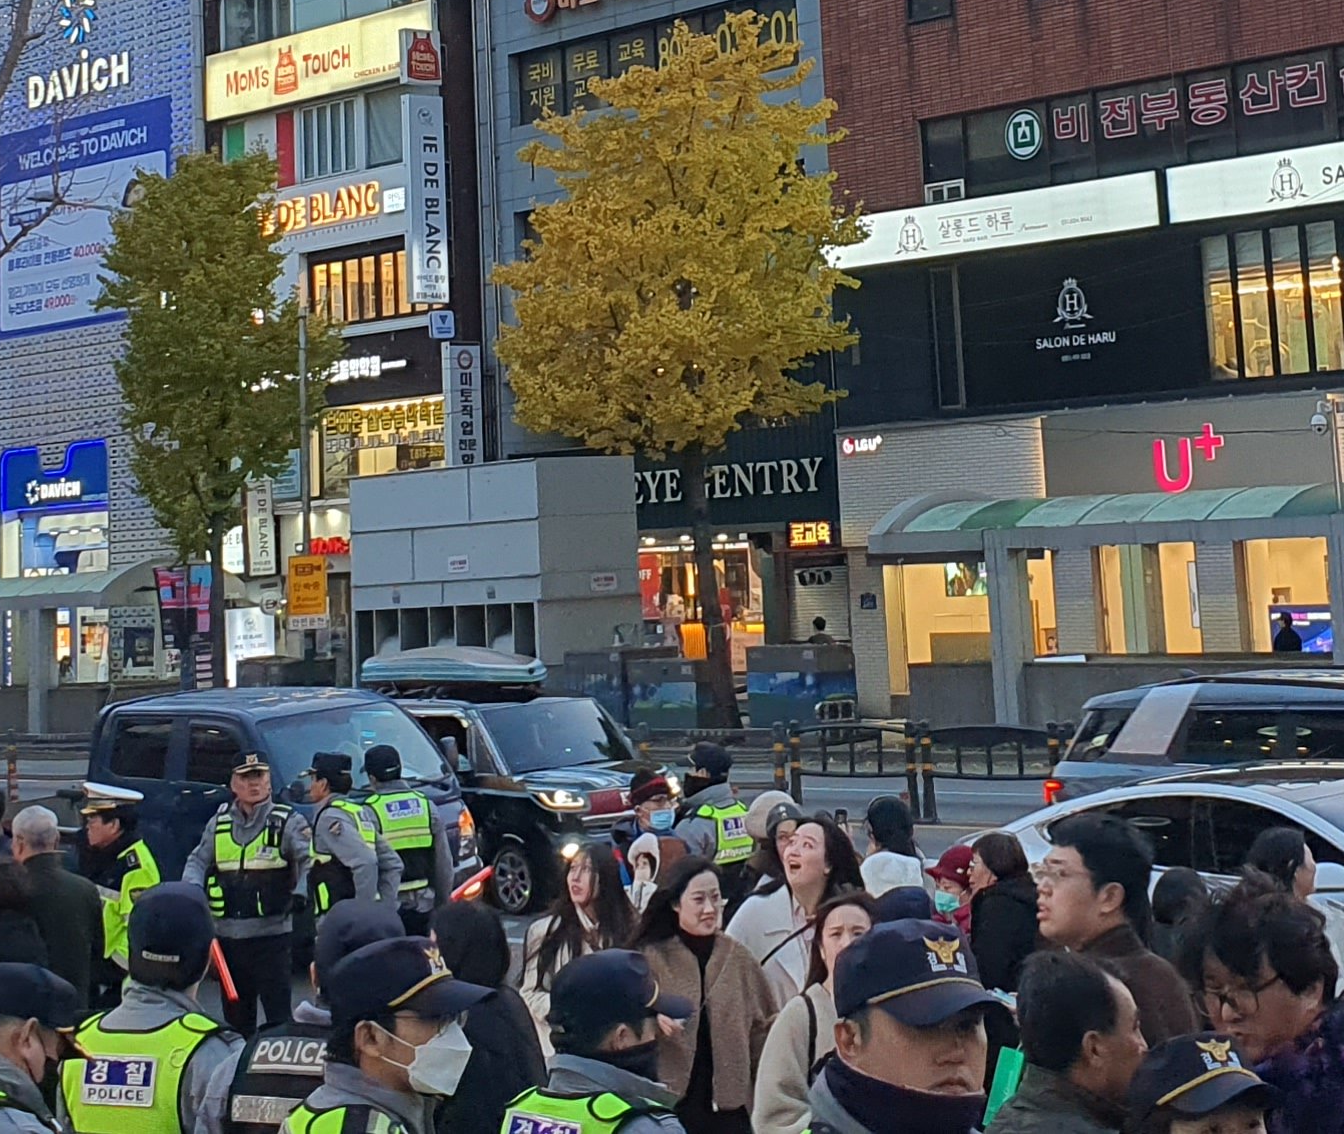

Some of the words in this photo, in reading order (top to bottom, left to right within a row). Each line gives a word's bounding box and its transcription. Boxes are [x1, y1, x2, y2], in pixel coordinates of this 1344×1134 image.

[302, 44, 351, 79] TOUCH
[572, 49, 600, 72] 무료
[618, 39, 646, 62] 교육
[527, 61, 554, 83] 국비
[529, 86, 555, 108] 지원
[18, 142, 80, 171] WELCOME
[81, 138, 99, 155] TO
[100, 126, 148, 153] DAVICH
[422, 135, 438, 154] IE
[423, 164, 439, 189] DE
[278, 196, 306, 233] DE
[309, 180, 381, 226] BLANC
[424, 196, 442, 269] BLANC
[938, 216, 981, 240] 살롱드
[986, 211, 1015, 232] 하루
[1035, 334, 1071, 351] SALON
[1072, 333, 1086, 347] DE
[1087, 330, 1117, 345] HARU
[459, 371, 474, 436] 미토직업
[458, 438, 477, 452] 전문
[1152, 422, 1225, 494] U+
[705, 457, 824, 499] ENTRY
[258, 499, 267, 512] DE
[259, 519, 269, 558] BLANC
[254, 1039, 328, 1064] POLICE
[88, 1059, 147, 1086] 경찰
[86, 1085, 145, 1102] POLICE
